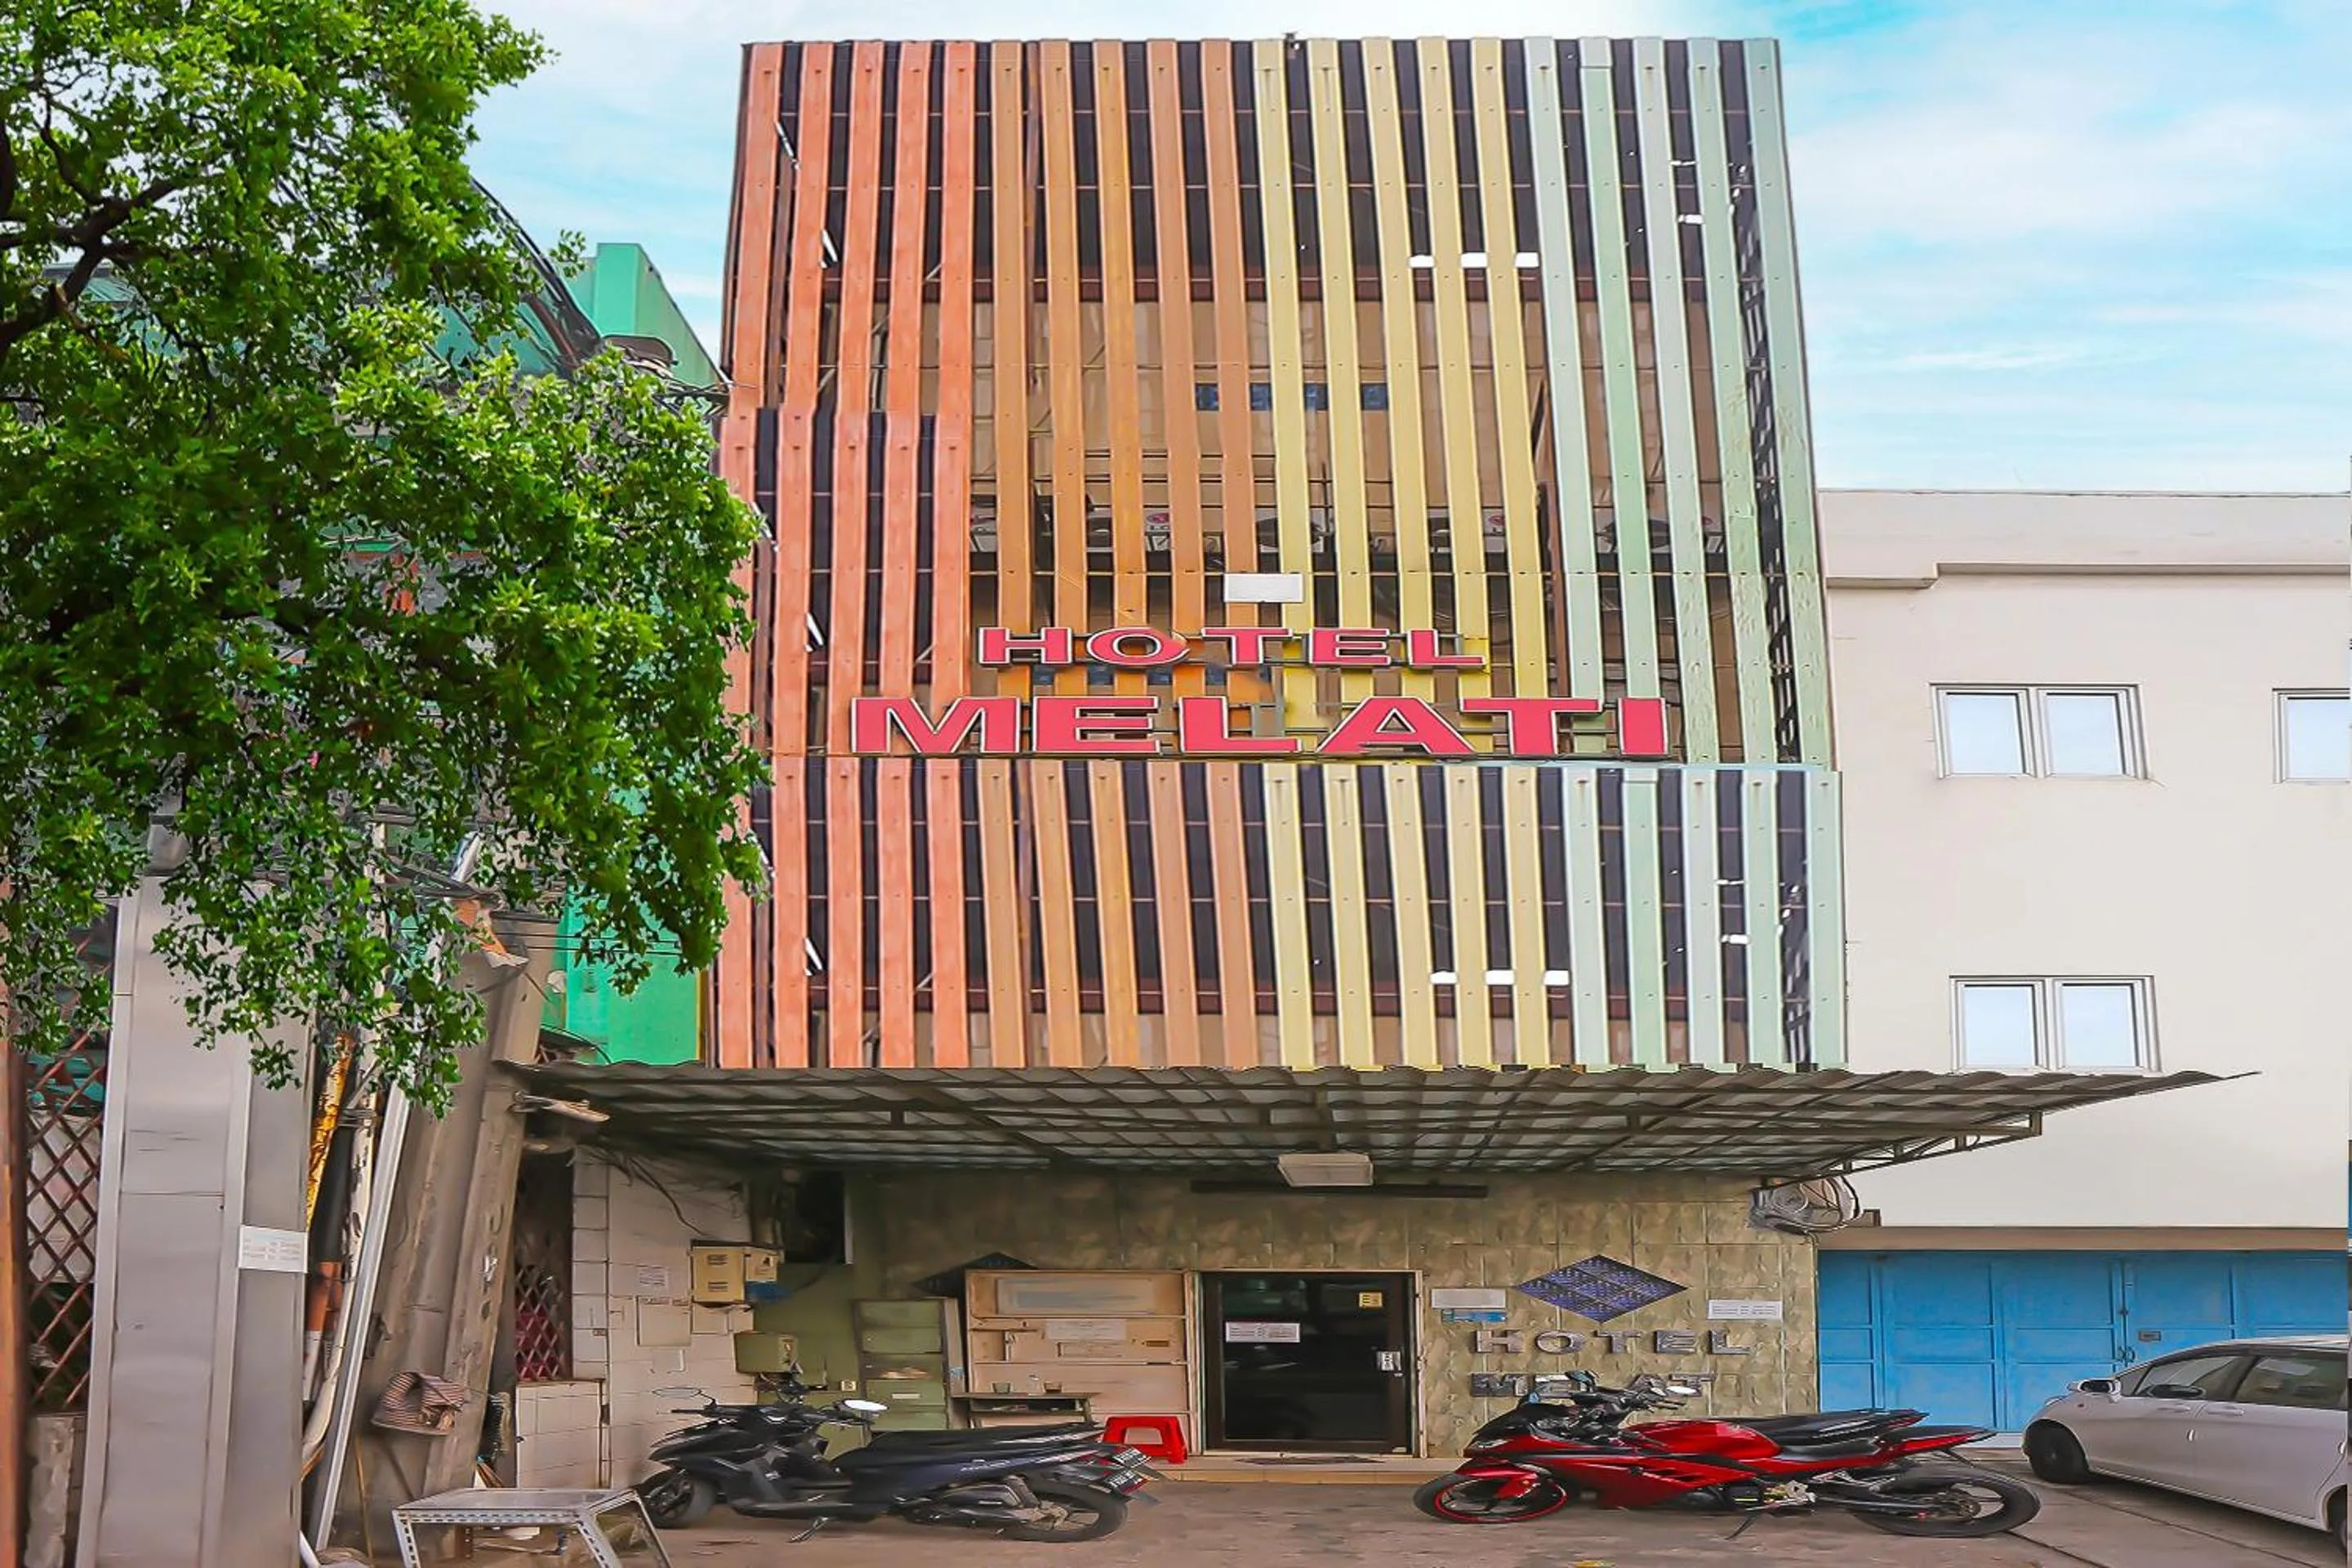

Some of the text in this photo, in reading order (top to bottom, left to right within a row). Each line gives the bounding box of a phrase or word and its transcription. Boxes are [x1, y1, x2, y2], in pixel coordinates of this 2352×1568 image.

[978, 626, 1486, 668] HOTEL
[851, 696, 1668, 755] MELATI
[1472, 1329, 1751, 1355] HOTEL
